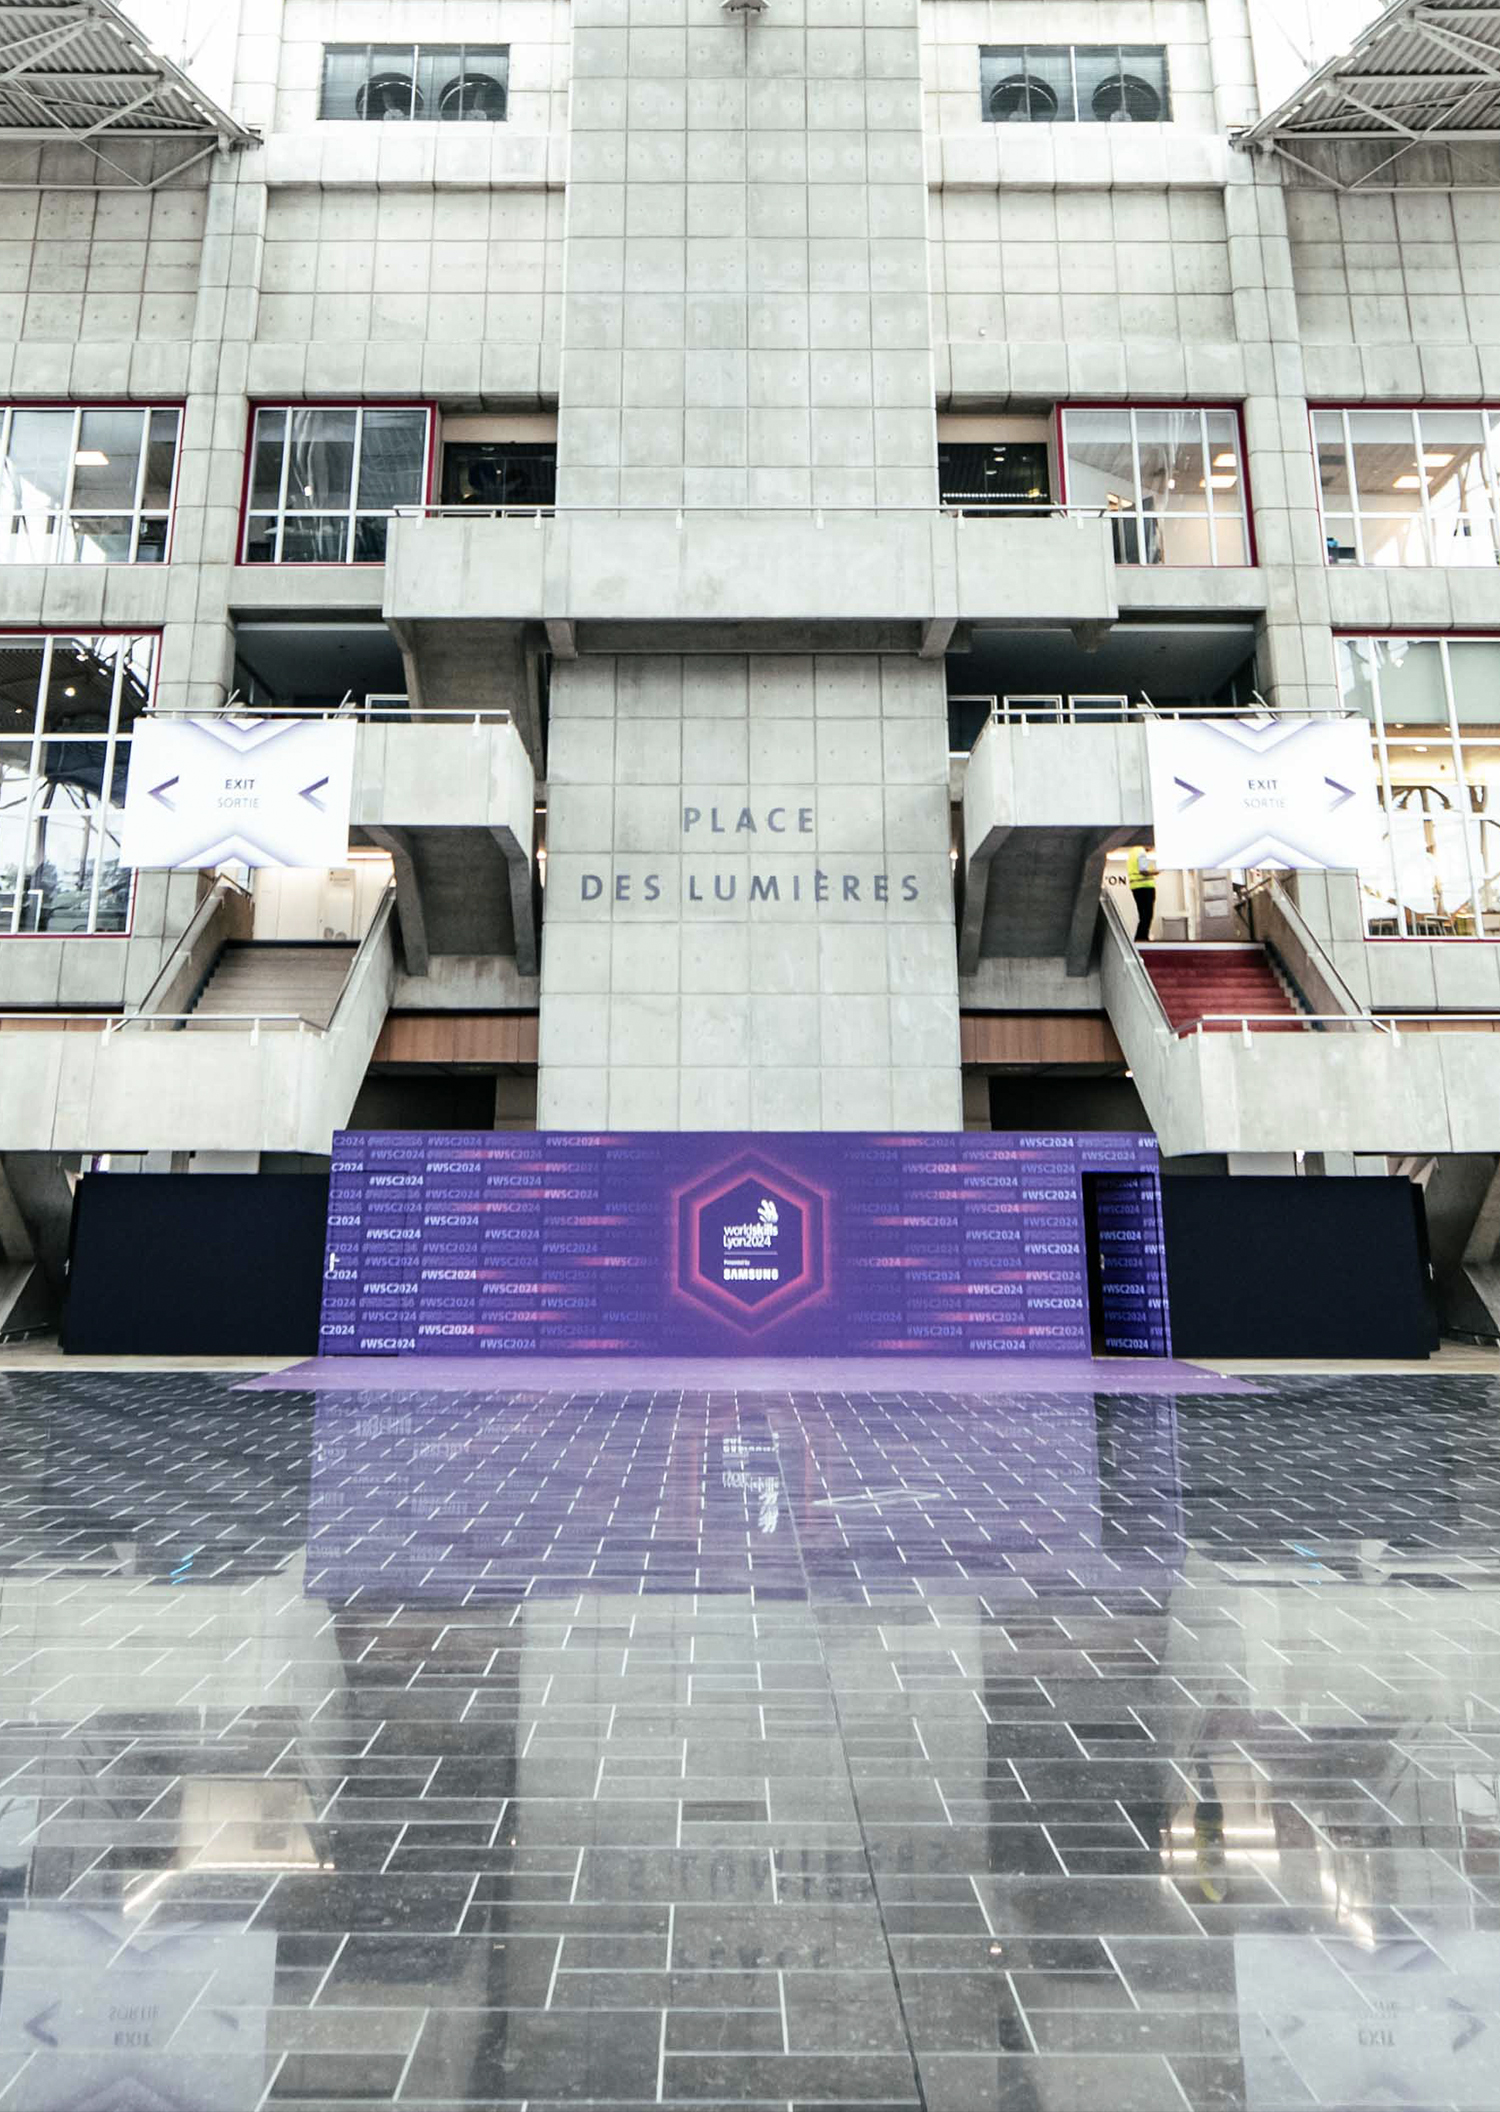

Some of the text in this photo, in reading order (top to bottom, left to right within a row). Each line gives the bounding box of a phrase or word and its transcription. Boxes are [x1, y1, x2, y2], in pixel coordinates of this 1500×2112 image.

[225, 779, 255, 790] EXIT
[1248, 779, 1278, 790] EXIT
[217, 797, 260, 808] SORTIE
[684, 807, 814, 833] PLACE
[581, 869, 920, 902] DES LUMIÈRES
[546, 1136, 600, 1146] #WSC2024
[1020, 1137, 1074, 1147] #WSC2024
[370, 1150, 424, 1159] #WSC2024
[962, 1151, 1017, 1160] #WSC2024
[1082, 1151, 1135, 1160] #WSC2024
[426, 1163, 481, 1172] #WSC2024
[902, 1164, 957, 1173] #WSC2024
[1021, 1164, 1075, 1173] #WSC2024
[370, 1176, 541, 1186] #WSC2024 #WSC2024
[964, 1177, 1018, 1187] #WSC2024
[425, 1189, 480, 1199] #WSC2024
[544, 1189, 598, 1199] #WSC2024
[1023, 1190, 1077, 1200] #WSC2024
[368, 1203, 422, 1212] #WSC2024
[486, 1203, 540, 1212] #WSC2024
[965, 1204, 1019, 1213] #WSC2024
[424, 1216, 479, 1226] #WSC2024
[903, 1217, 1078, 1226] #WSC2024 #WSC2024
[366, 1229, 540, 1239] #WSC2024 #WSC2024
[966, 1230, 1020, 1240] #WSC2024
[423, 1243, 477, 1252] #WSC2024
[543, 1243, 597, 1252] #WSC2024
[1025, 1244, 1080, 1254] #WSC2024
[365, 1256, 419, 1266] #WSC2024
[484, 1256, 539, 1266] #WSC2024
[422, 1270, 476, 1280] #WSC2024
[724, 1268, 778, 1280] SAMSUNG
[905, 1271, 1081, 1281] #WSC2024 #WSC2024
[364, 1284, 538, 1294] #WSC2024 #WSC2024
[968, 1284, 1022, 1295] #WSC2024
[1103, 1284, 1144, 1295] #WSC2024
[420, 1298, 475, 1307] #WSC2024
[541, 1298, 596, 1307] #WSC2024
[1028, 1299, 1083, 1309] #WSC2024
[482, 1311, 537, 1321] #WSC2024
[969, 1312, 1024, 1322] #WSC2024
[419, 1325, 474, 1335] #WSC2024
[908, 1326, 1084, 1336] #WSC2024 #WSC2024
[360, 1339, 415, 1349] #WSC2024
[480, 1339, 536, 1349] #WSC2024
[970, 1340, 1025, 1350] #WSC2024
[1106, 1340, 1148, 1350] #WSC2024
